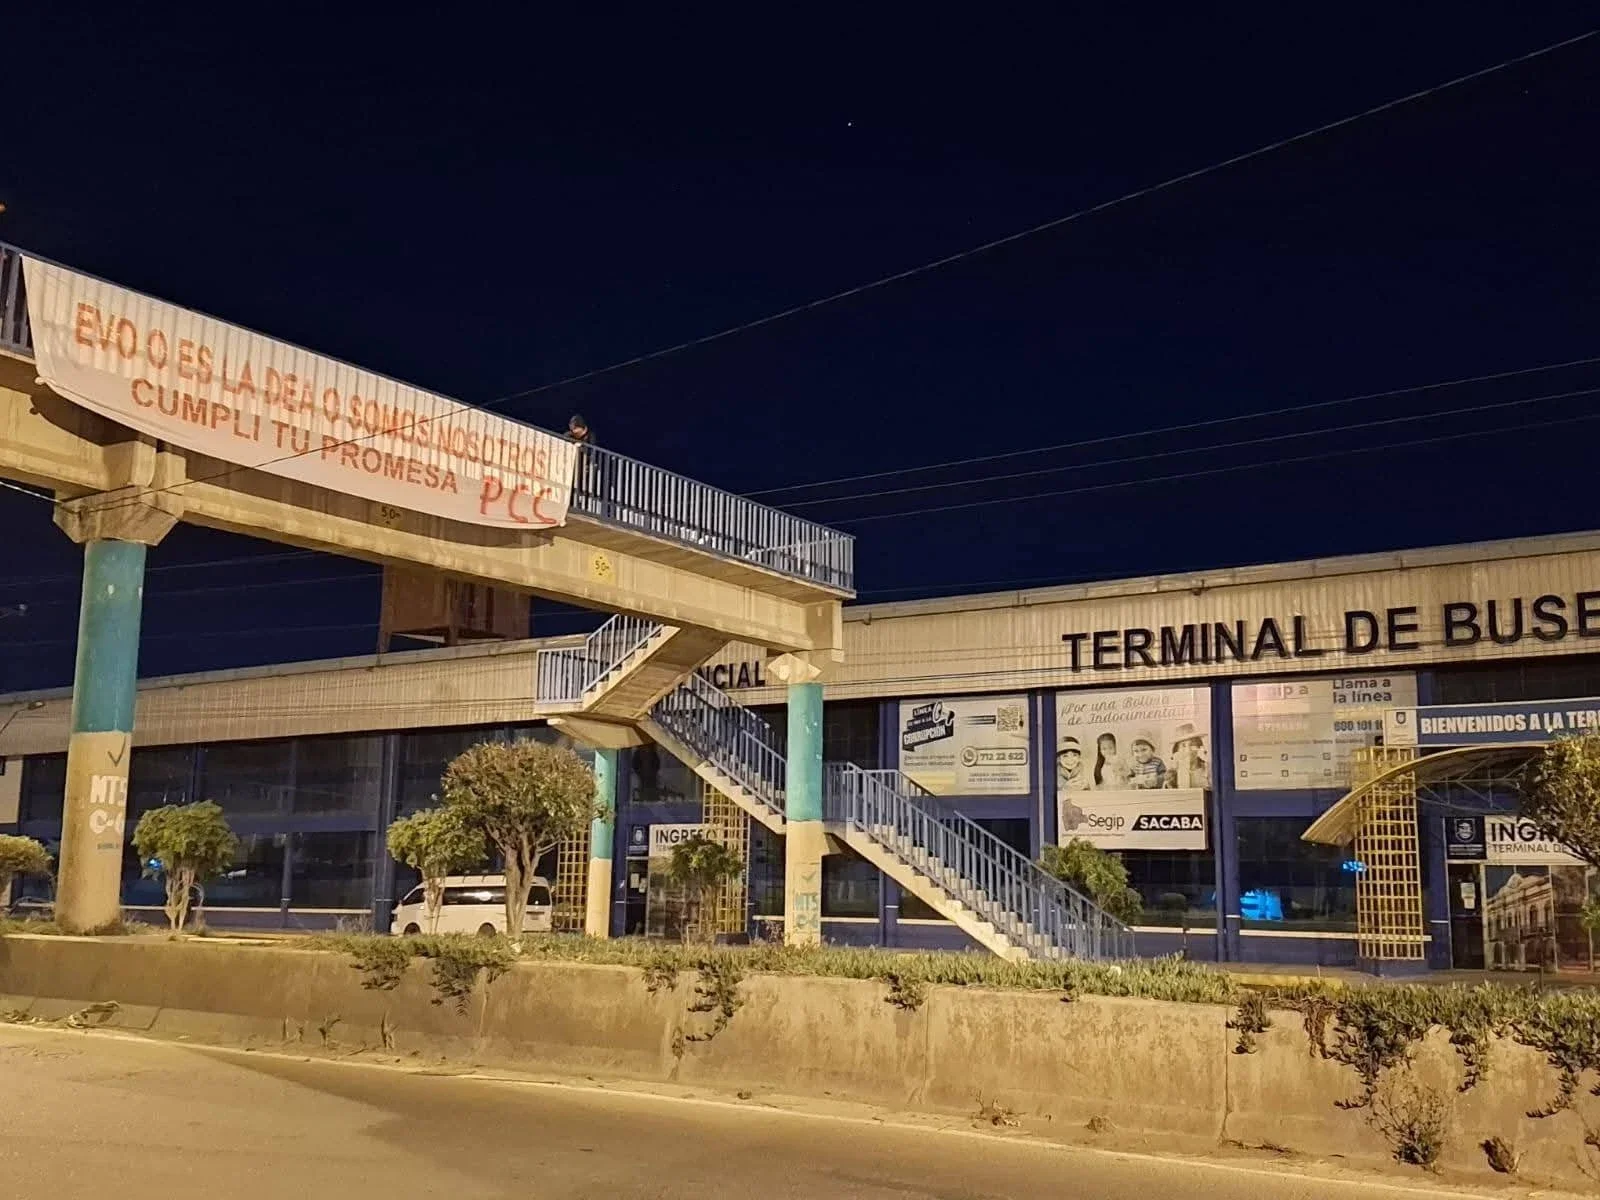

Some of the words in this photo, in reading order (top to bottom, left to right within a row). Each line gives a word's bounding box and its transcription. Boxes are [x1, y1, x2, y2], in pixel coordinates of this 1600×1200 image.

[76, 302, 137, 359] EVO
[147, 328, 168, 369] O
[179, 337, 213, 384] ES
[223, 351, 256, 398] LA
[264, 366, 315, 418] DEA
[323, 387, 340, 424] O
[349, 394, 432, 448] SOMOS
[440, 420, 547, 480] NOSOTROS
[131, 378, 260, 442] CUMPLI
[271, 420, 310, 454] TU
[321, 434, 458, 494] PROMESA
[1062, 615, 1324, 673] TERMINAL
[1344, 606, 1420, 653] DE
[1443, 591, 1600, 648] BUSE
[1333, 679, 1377, 689] Llama
[1382, 679, 1391, 688] a
[1333, 692, 1347, 703] la
[1421, 714, 1526, 734] BIENVENIDOS
[1529, 713, 1541, 730] A
[1543, 712, 1564, 730] LA
[1088, 813, 1125, 830] Segip
[1140, 816, 1203, 829] SACABA
[1493, 844, 1550, 853] TERMINAL
